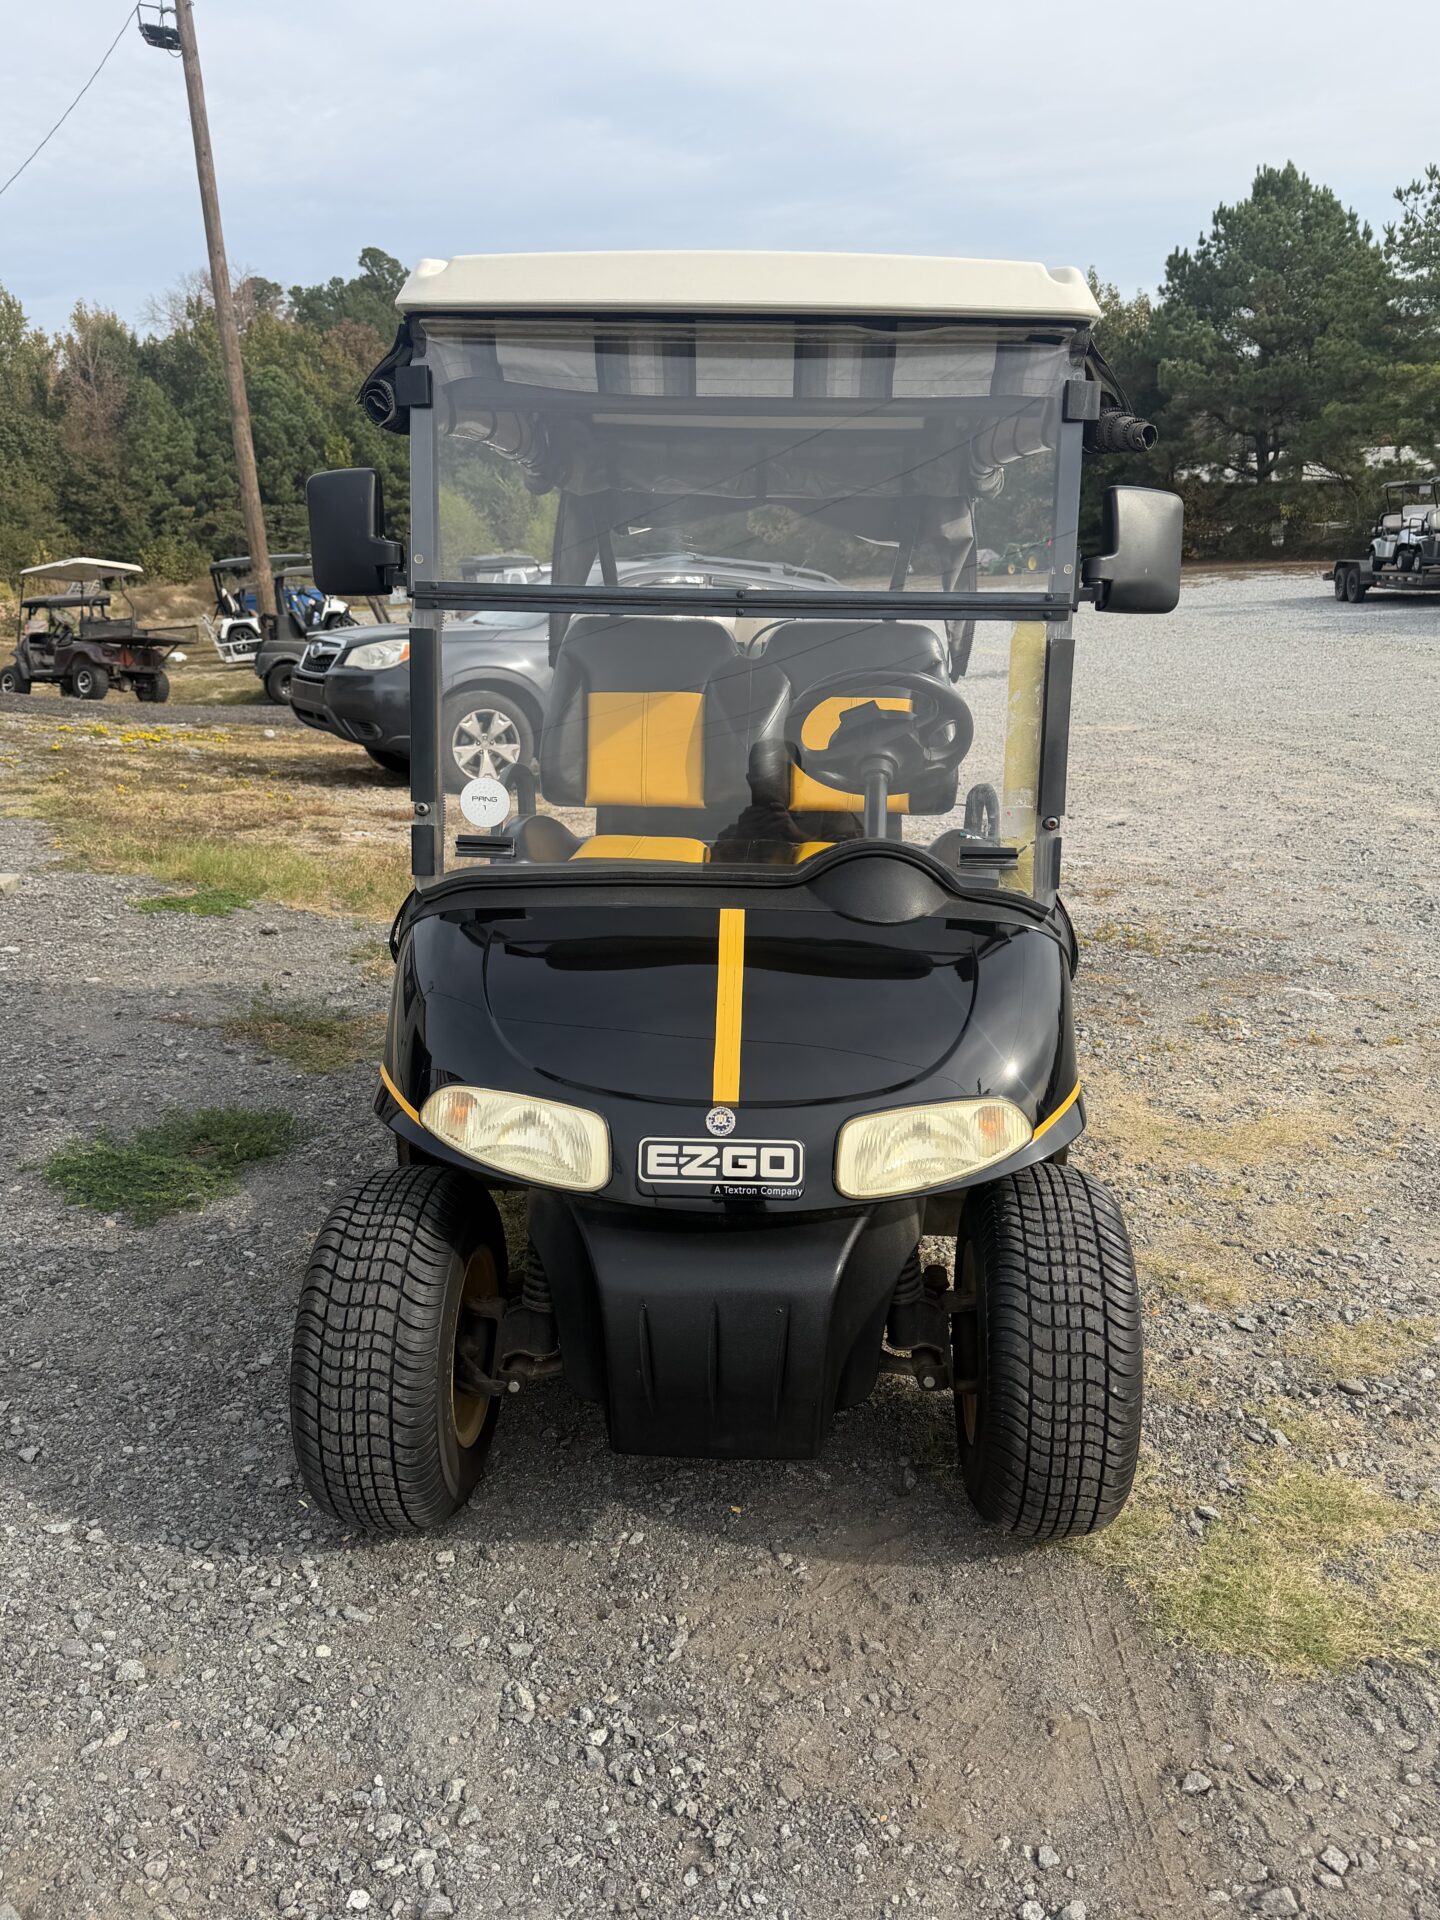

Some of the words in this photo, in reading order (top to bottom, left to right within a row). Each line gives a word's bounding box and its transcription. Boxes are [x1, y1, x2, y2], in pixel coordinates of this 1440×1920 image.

[714, 1185, 721, 1194] A
[723, 1185, 758, 1195] Textron
[760, 1186, 803, 1197] Company
